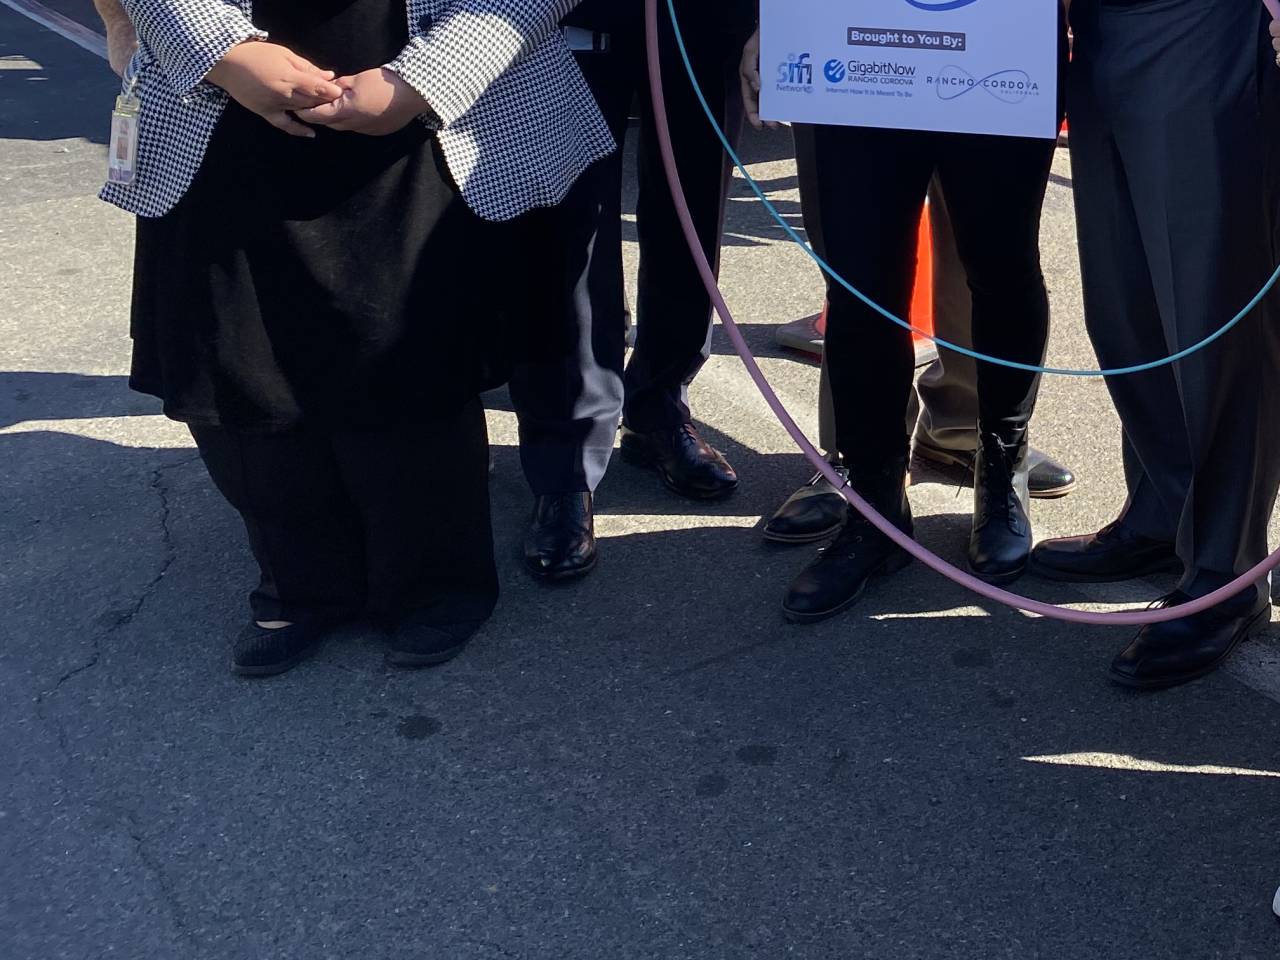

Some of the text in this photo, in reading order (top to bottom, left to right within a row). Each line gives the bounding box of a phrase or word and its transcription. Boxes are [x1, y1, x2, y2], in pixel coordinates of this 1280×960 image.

[851, 30, 963, 48] Brought to You By:
[847, 60, 916, 77] GigabitNow
[847, 76, 914, 86] RANCHO CORDOVA
[926, 76, 1039, 91] RANCHO CORDOVA
